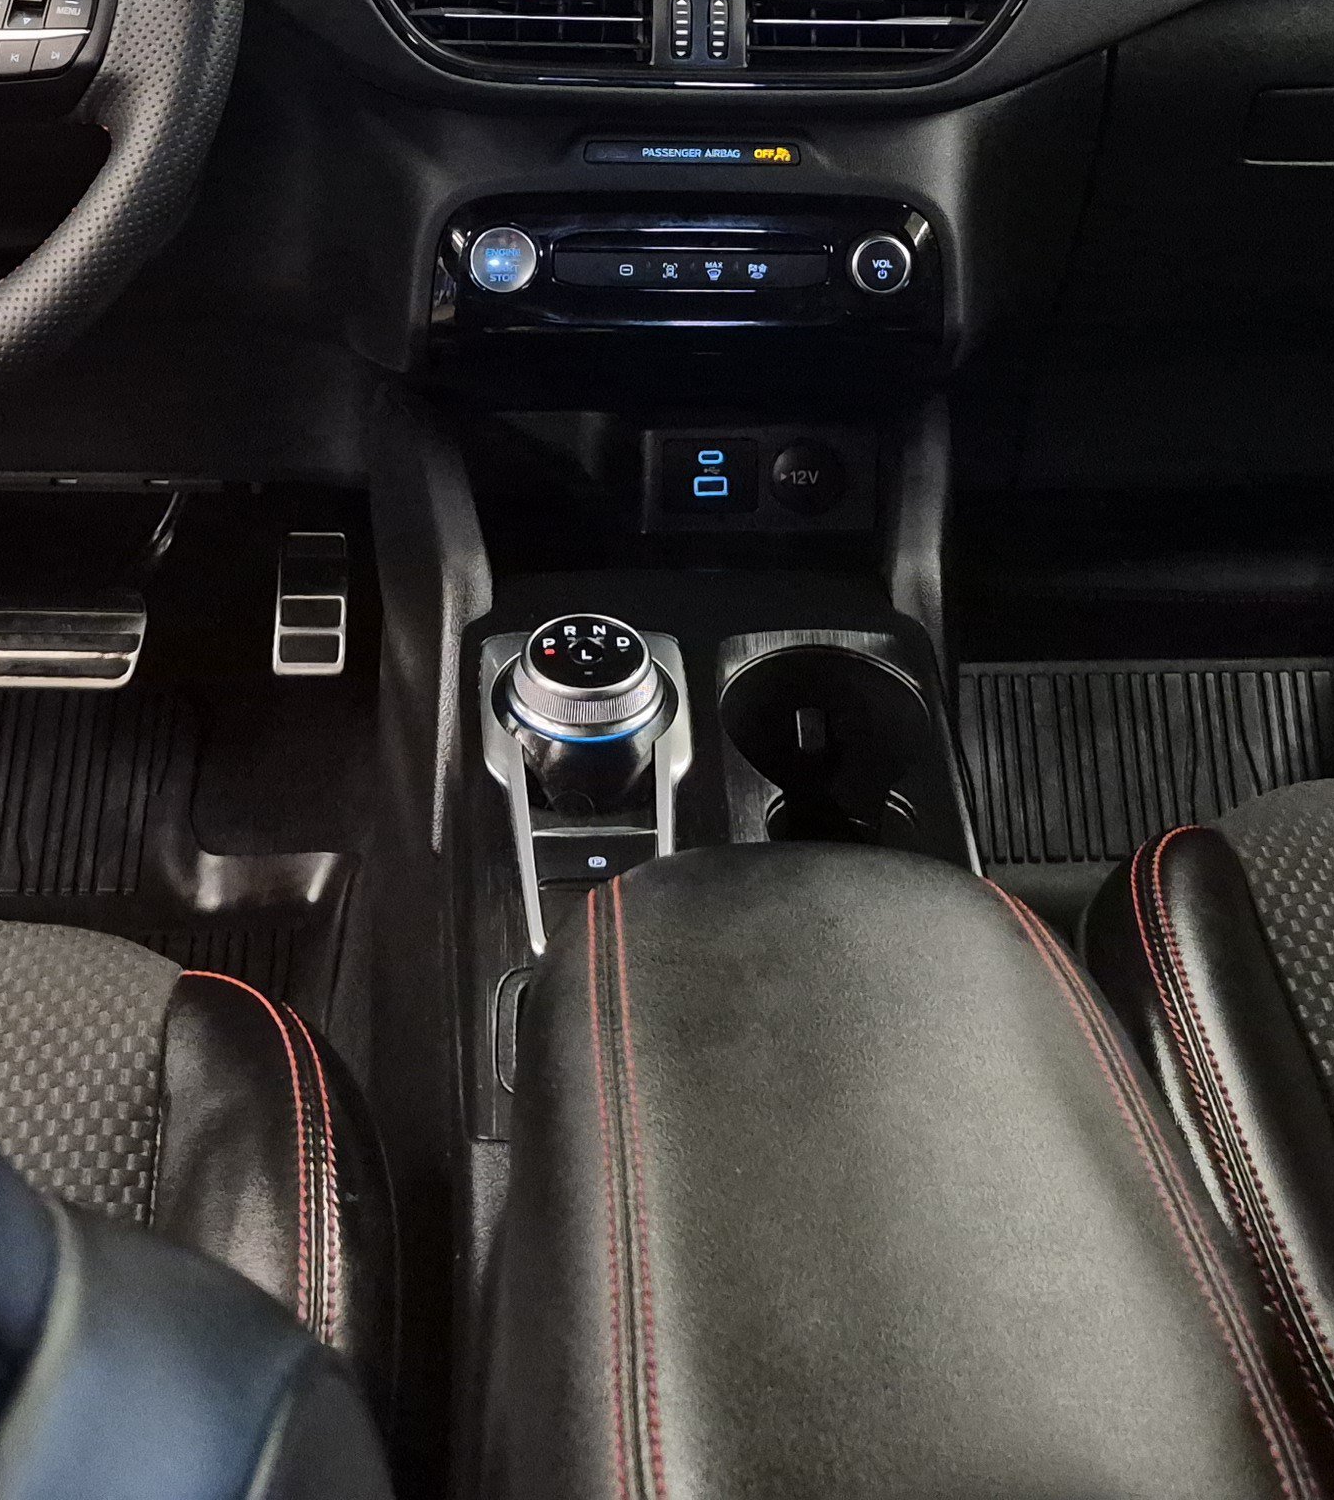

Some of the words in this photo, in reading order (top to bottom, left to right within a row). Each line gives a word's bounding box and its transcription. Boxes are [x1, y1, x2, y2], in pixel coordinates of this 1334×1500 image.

[55, 6, 82, 17] MENU
[641, 147, 702, 159] PASSENGER
[704, 148, 741, 159] AIRBAG
[753, 148, 774, 160] OFF
[704, 261, 724, 269] MAX
[871, 258, 894, 269] VOL
[489, 273, 519, 282] STOP
[789, 469, 819, 485] 12V
[563, 625, 577, 636] R
[592, 625, 607, 636] N
[542, 638, 556, 648] P
[616, 637, 630, 647] D
[581, 649, 593, 660] L
